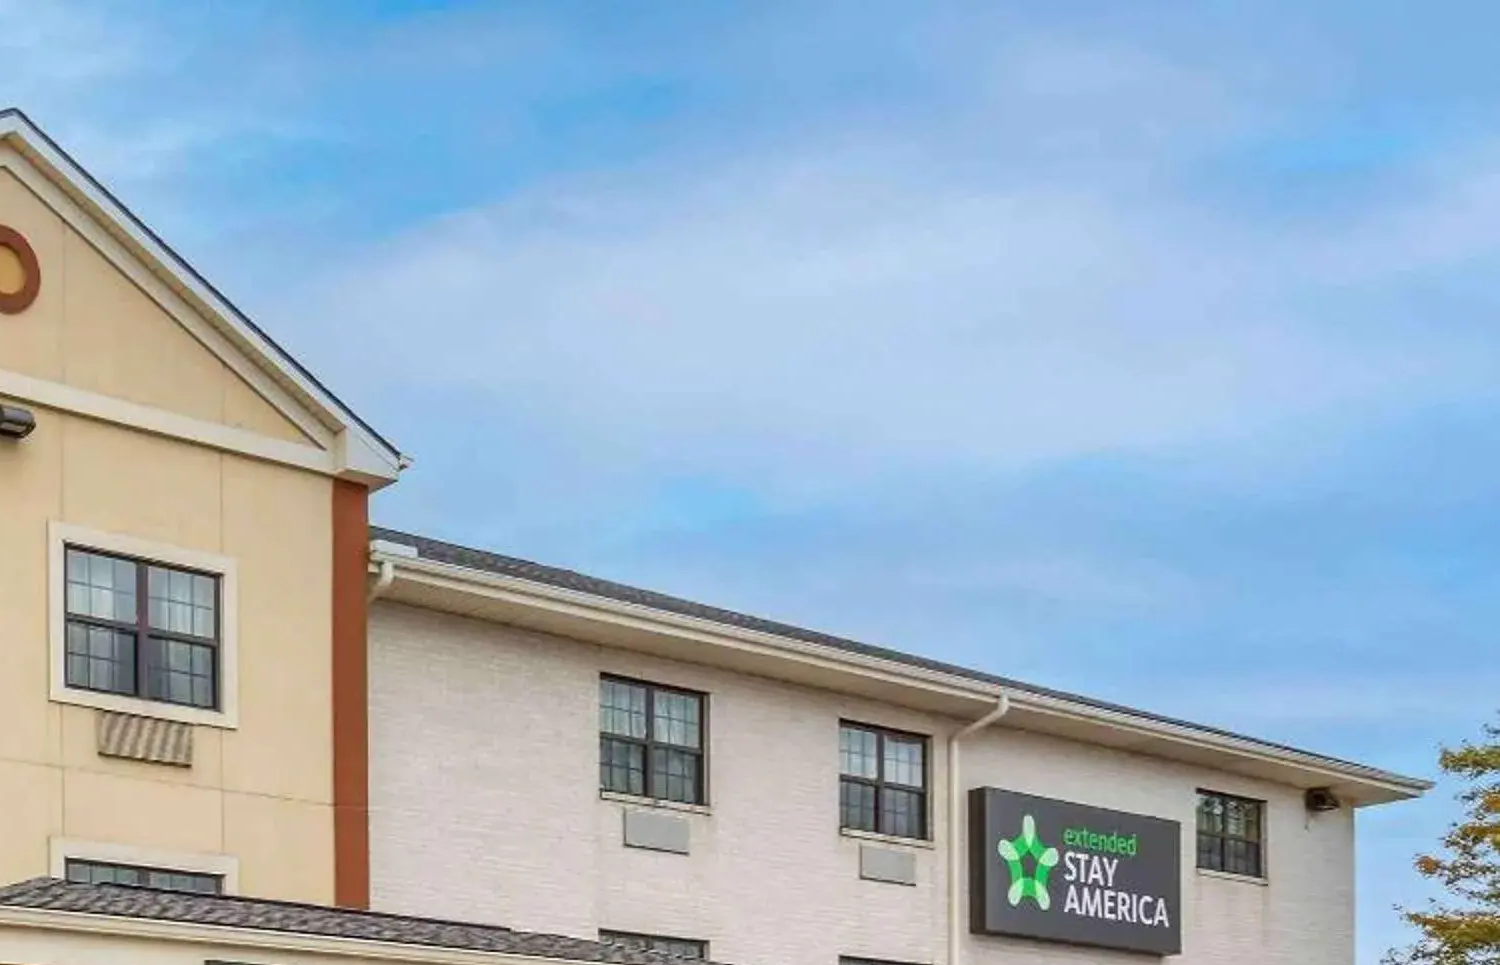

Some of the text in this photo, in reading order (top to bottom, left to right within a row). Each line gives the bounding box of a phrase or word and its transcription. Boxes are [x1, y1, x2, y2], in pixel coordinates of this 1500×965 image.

[1063, 828, 1137, 856] extended
[1064, 851, 1119, 887] STAY
[1064, 884, 1169, 928] AMERICA
